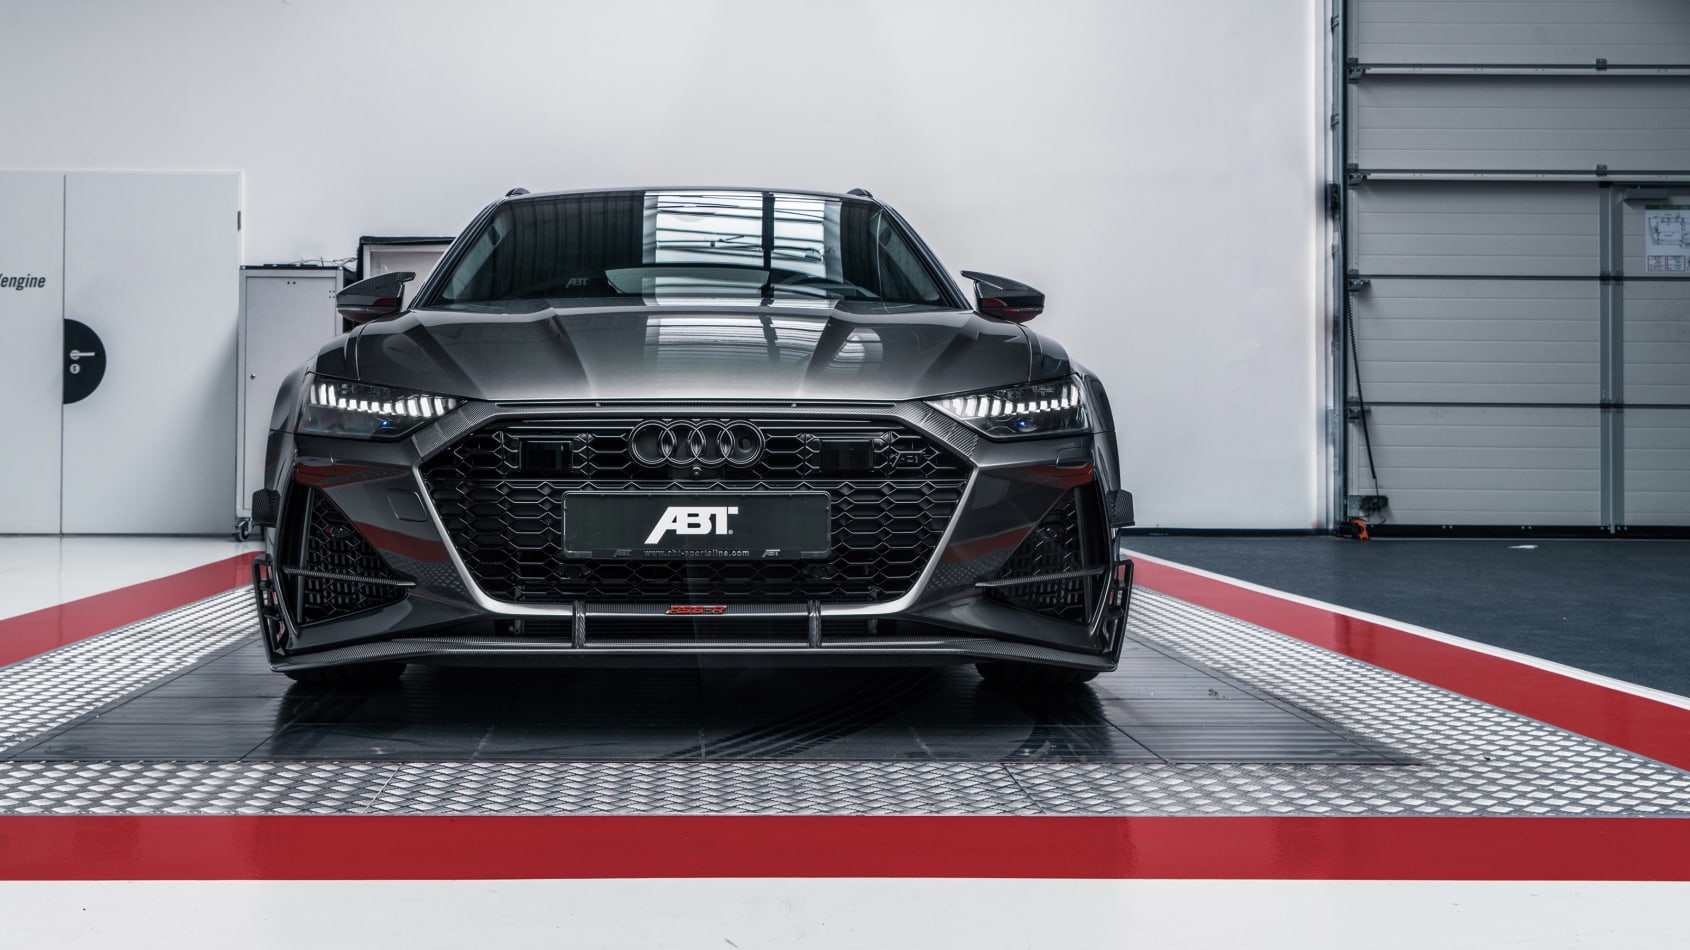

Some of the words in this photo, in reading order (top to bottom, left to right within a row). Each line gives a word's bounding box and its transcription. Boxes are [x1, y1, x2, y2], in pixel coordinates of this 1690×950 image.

[0, 273, 46, 291] engine
[565, 277, 589, 288] ABT
[644, 506, 739, 544] ABT
[762, 549, 780, 558] ABT
[669, 605, 725, 614] RS6-R
